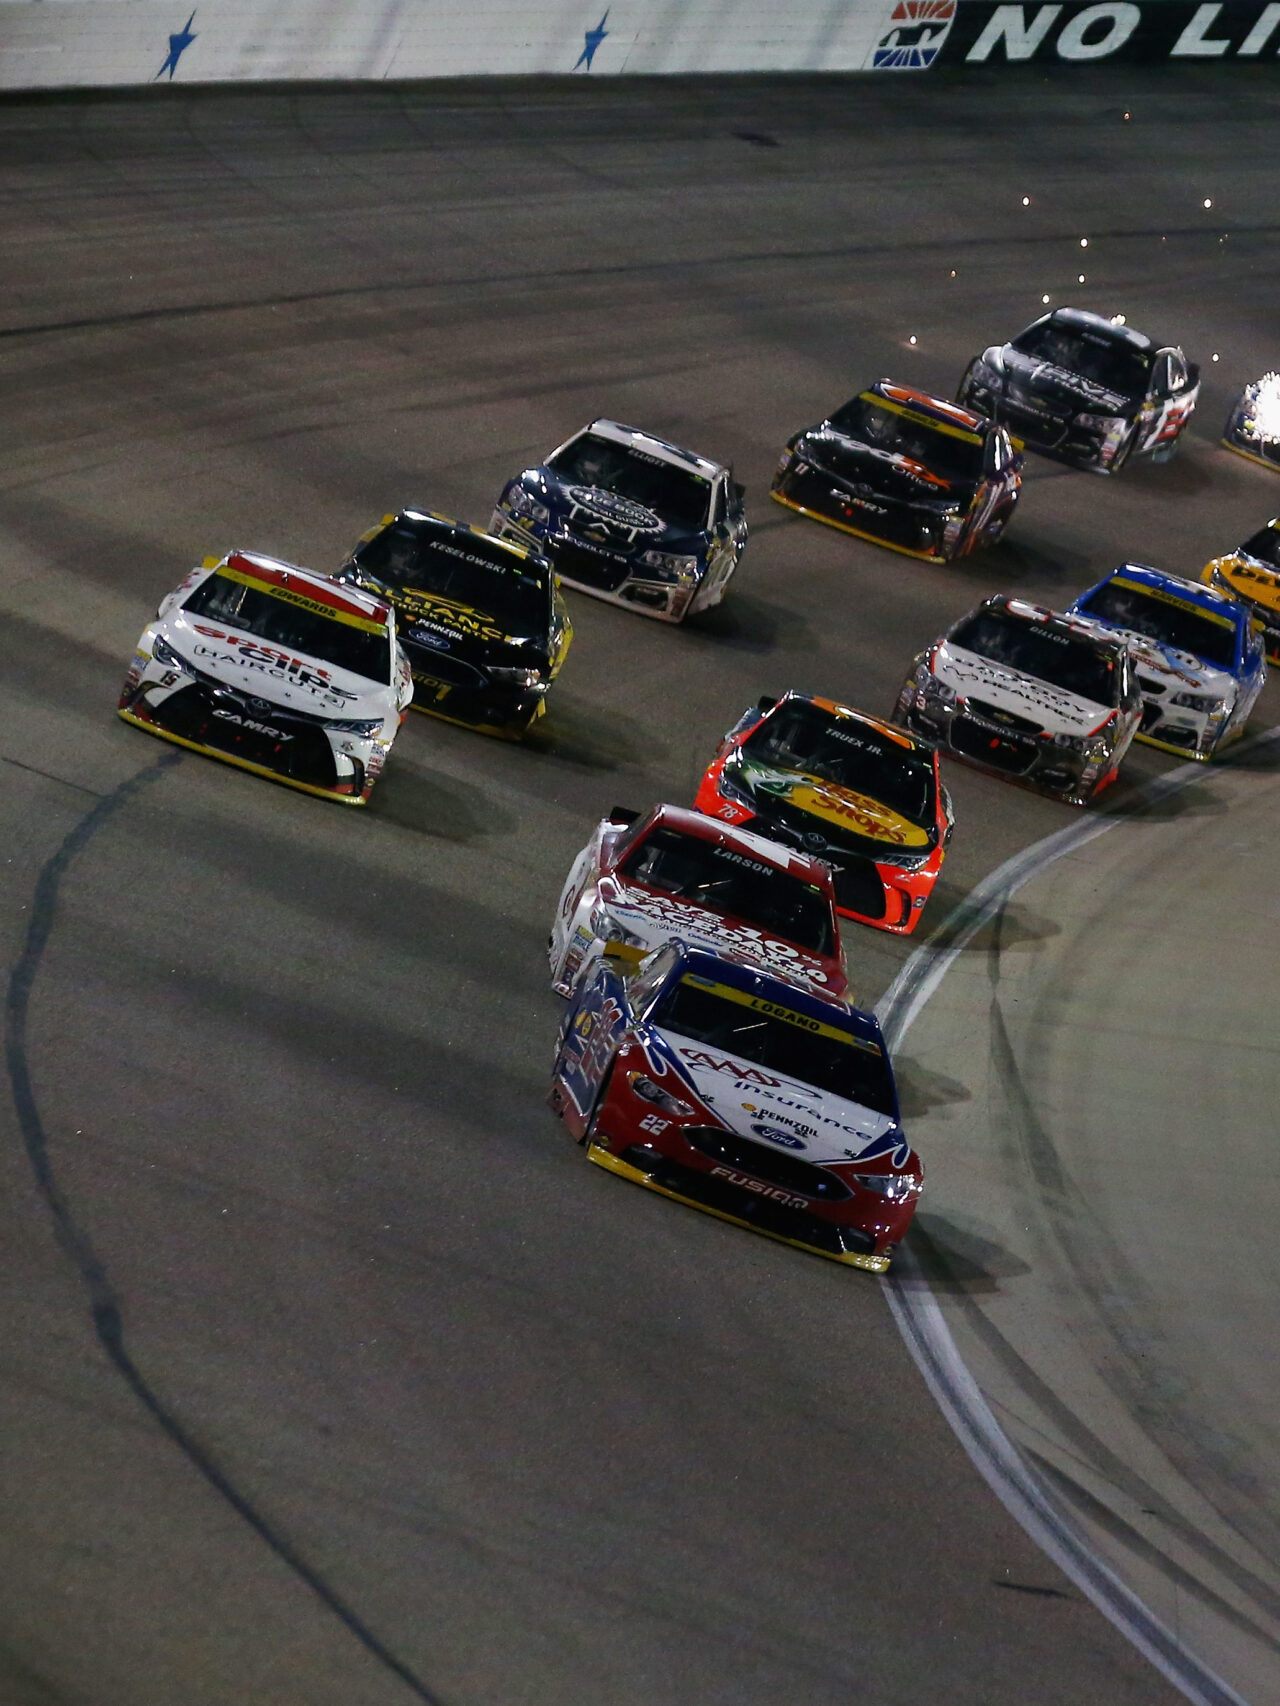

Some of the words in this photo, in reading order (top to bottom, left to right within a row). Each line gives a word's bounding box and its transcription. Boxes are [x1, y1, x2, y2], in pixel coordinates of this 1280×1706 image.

[965, 2, 1141, 62] NO
[429, 540, 507, 575] KESELOWSKI
[268, 586, 338, 618] EDWARDS
[417, 617, 465, 642] PENNZOIL
[1028, 624, 1071, 646] DILLON
[199, 647, 341, 706] HAIRCUTS
[237, 645, 359, 702] clips
[211, 707, 297, 742] CAMRY
[825, 727, 864, 749] TRUEX
[865, 743, 883, 757] JR.
[717, 802, 738, 820] 78
[811, 794, 907, 844] Shops
[712, 847, 774, 878] LARSON
[750, 998, 821, 1032] LOGANO
[637, 1112, 669, 1137] 22
[733, 1080, 873, 1141] Insurance
[760, 1108, 820, 1138] PENNZOIL
[760, 1128, 798, 1147] Ford
[709, 1166, 809, 1208] FUSION
